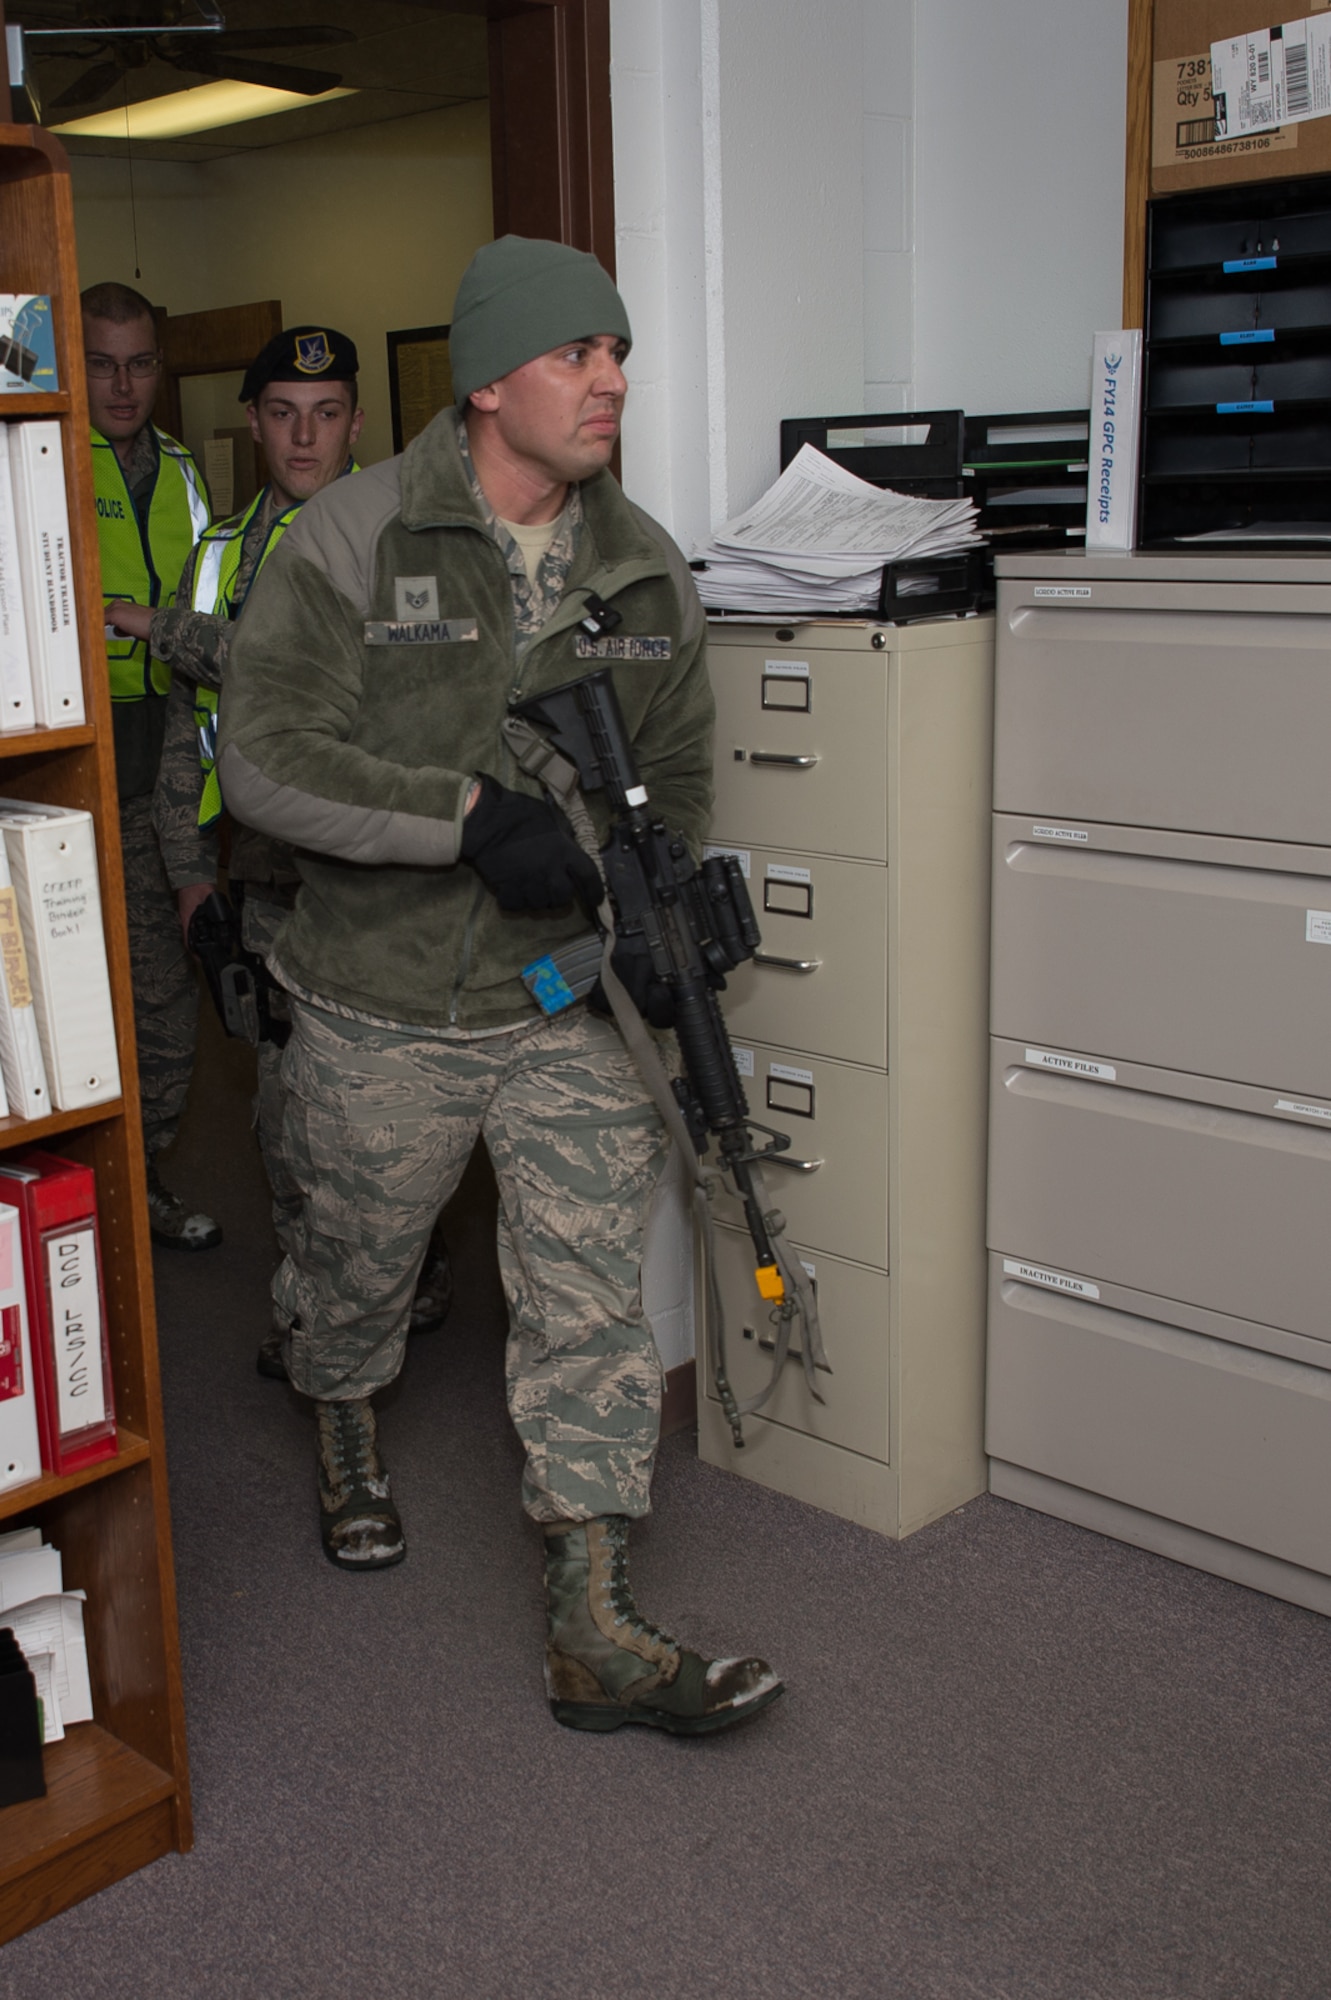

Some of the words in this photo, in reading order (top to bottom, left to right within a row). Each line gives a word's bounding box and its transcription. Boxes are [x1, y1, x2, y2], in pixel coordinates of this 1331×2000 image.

[1177, 90, 1199, 107] Qty
[1185, 138, 1270, 159] 50086486738106
[1104, 378, 1117, 416] FY14
[1102, 421, 1115, 454] GPC
[1097, 457, 1113, 524] Receipts
[97, 497, 125, 519] OLICE
[42, 532, 53, 575] STUDENT
[57, 537, 66, 581] TRACTOR
[47, 579, 58, 633] HANDBOOK
[61, 584, 70, 626] TRAILER
[388, 623, 451, 642] WALKAMA
[606, 639, 625, 656] AIR
[629, 639, 671, 658] FORCE
[1042, 1055, 1073, 1069] ACTIVE
[1074, 1062, 1099, 1074] FILES
[1020, 1266, 1058, 1285] INACTIVE
[1059, 1278, 1083, 1291] FILES
